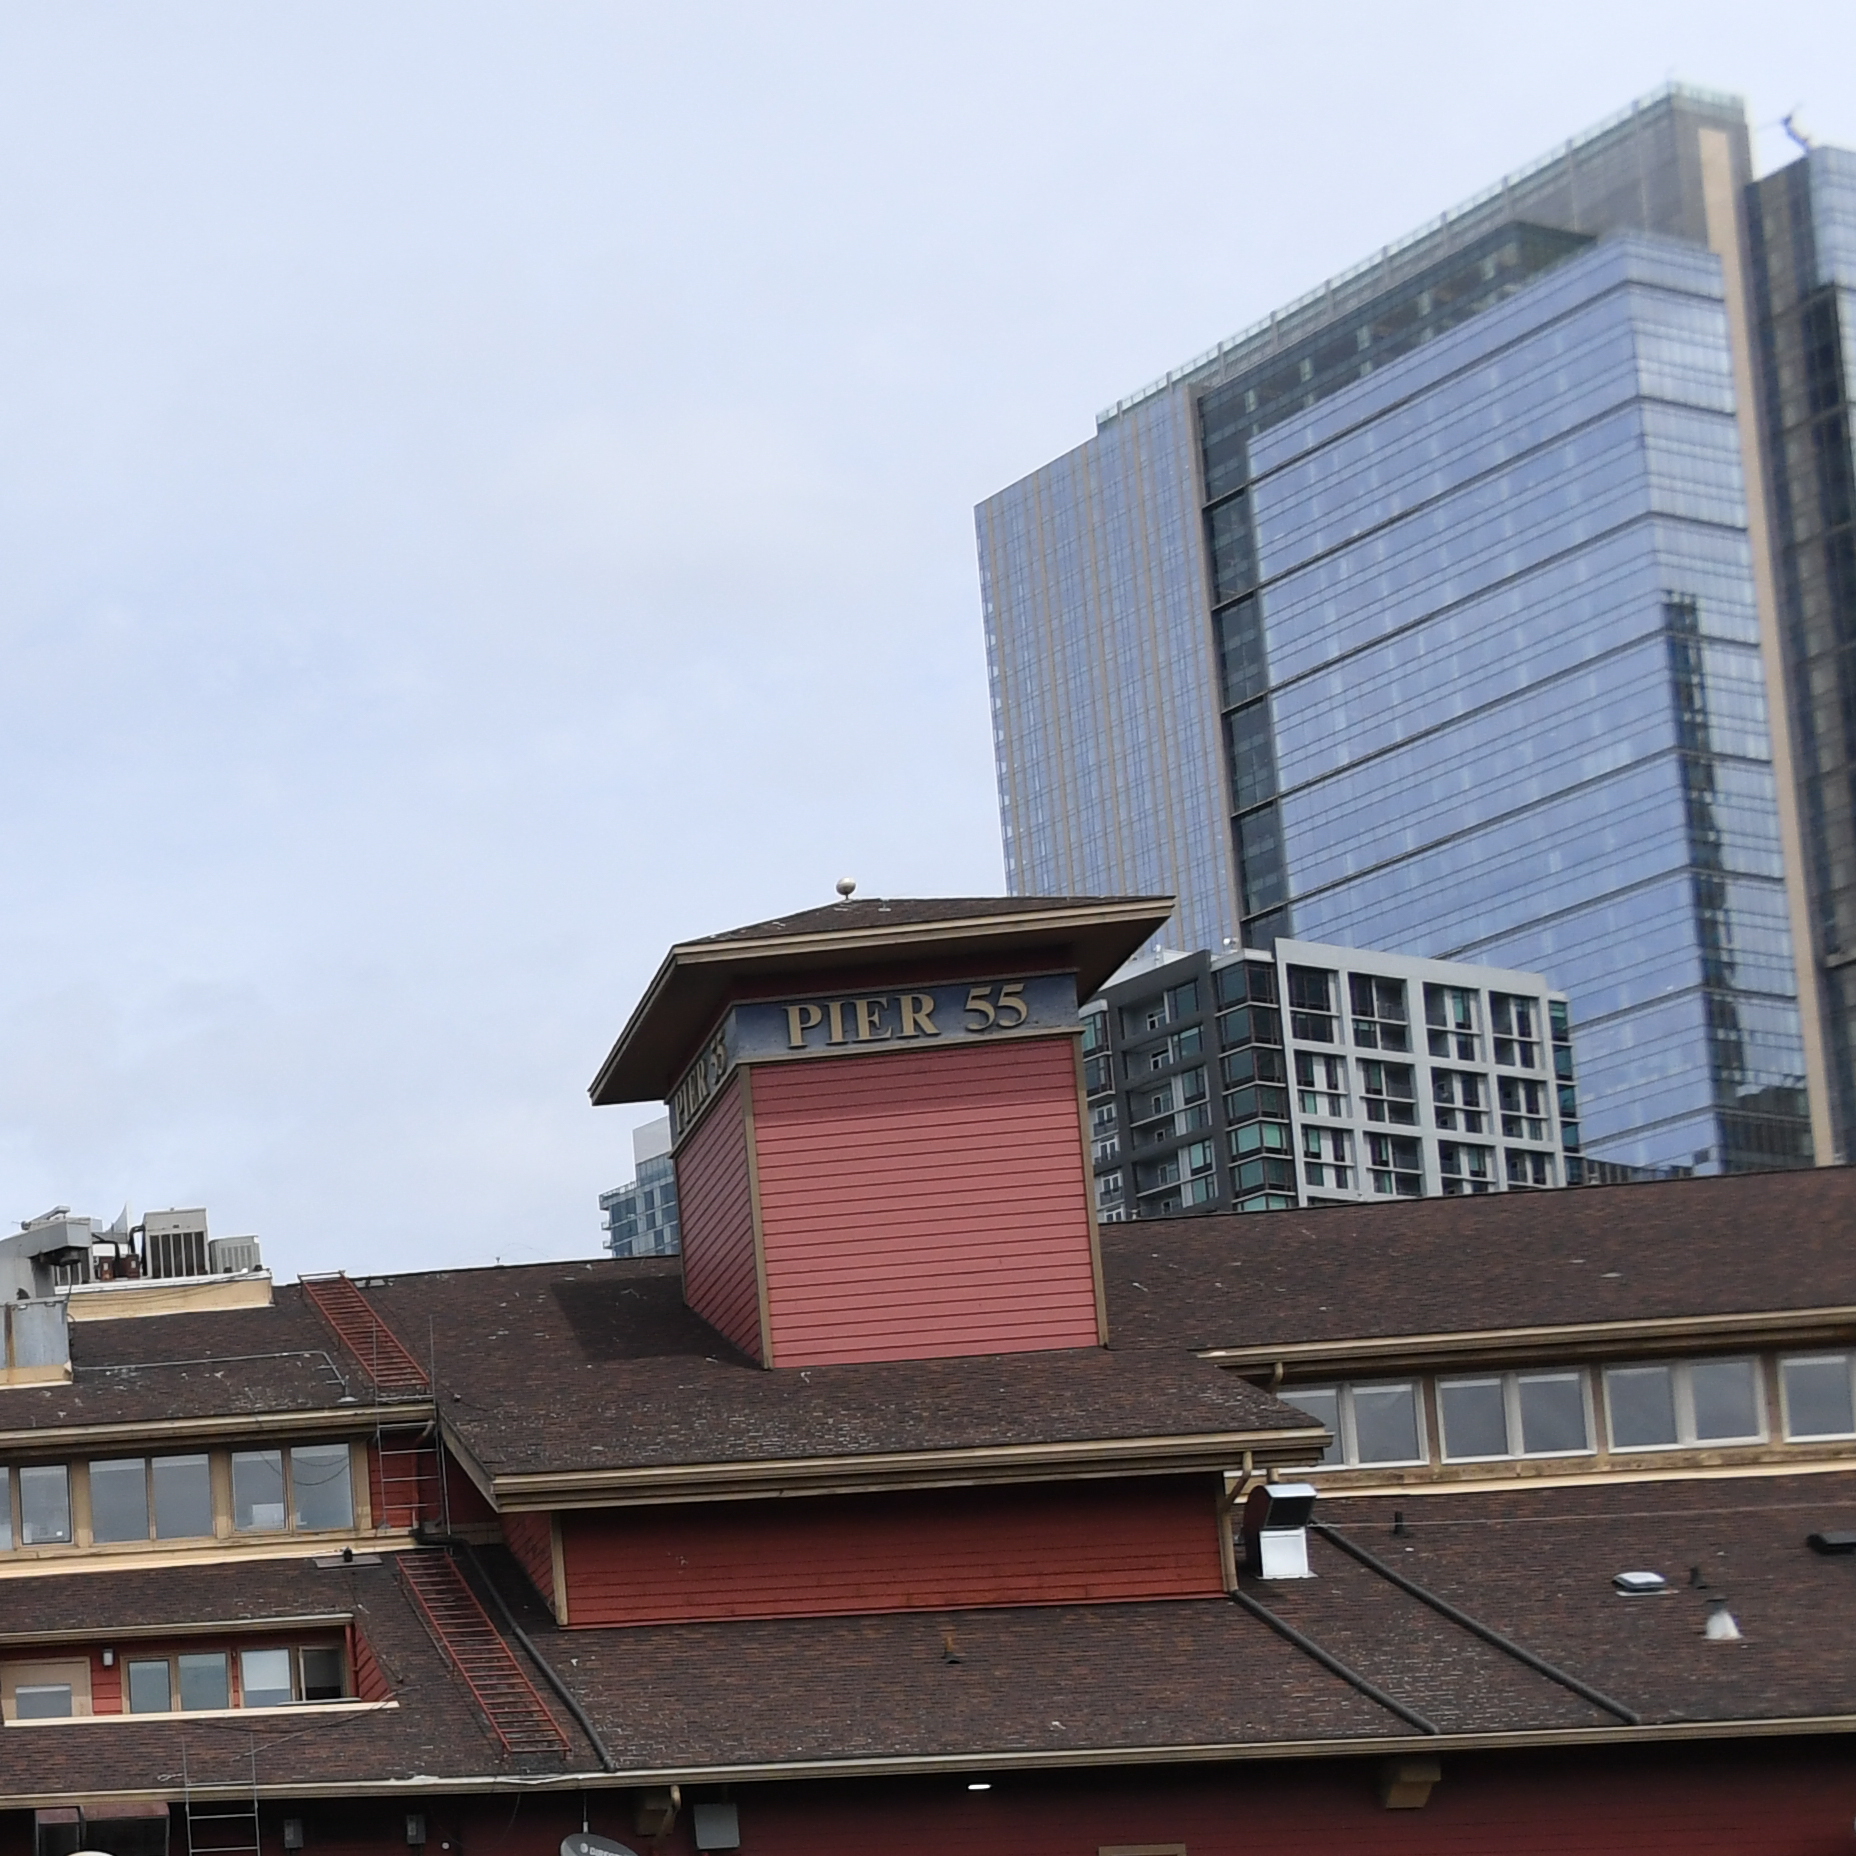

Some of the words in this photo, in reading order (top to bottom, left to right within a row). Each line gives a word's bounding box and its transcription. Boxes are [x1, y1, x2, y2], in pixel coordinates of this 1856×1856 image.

[784, 993, 941, 1049] PIER
[964, 983, 1029, 1031] 55
[674, 1059, 709, 1134] PIER
[710, 1028, 727, 1086] 55
